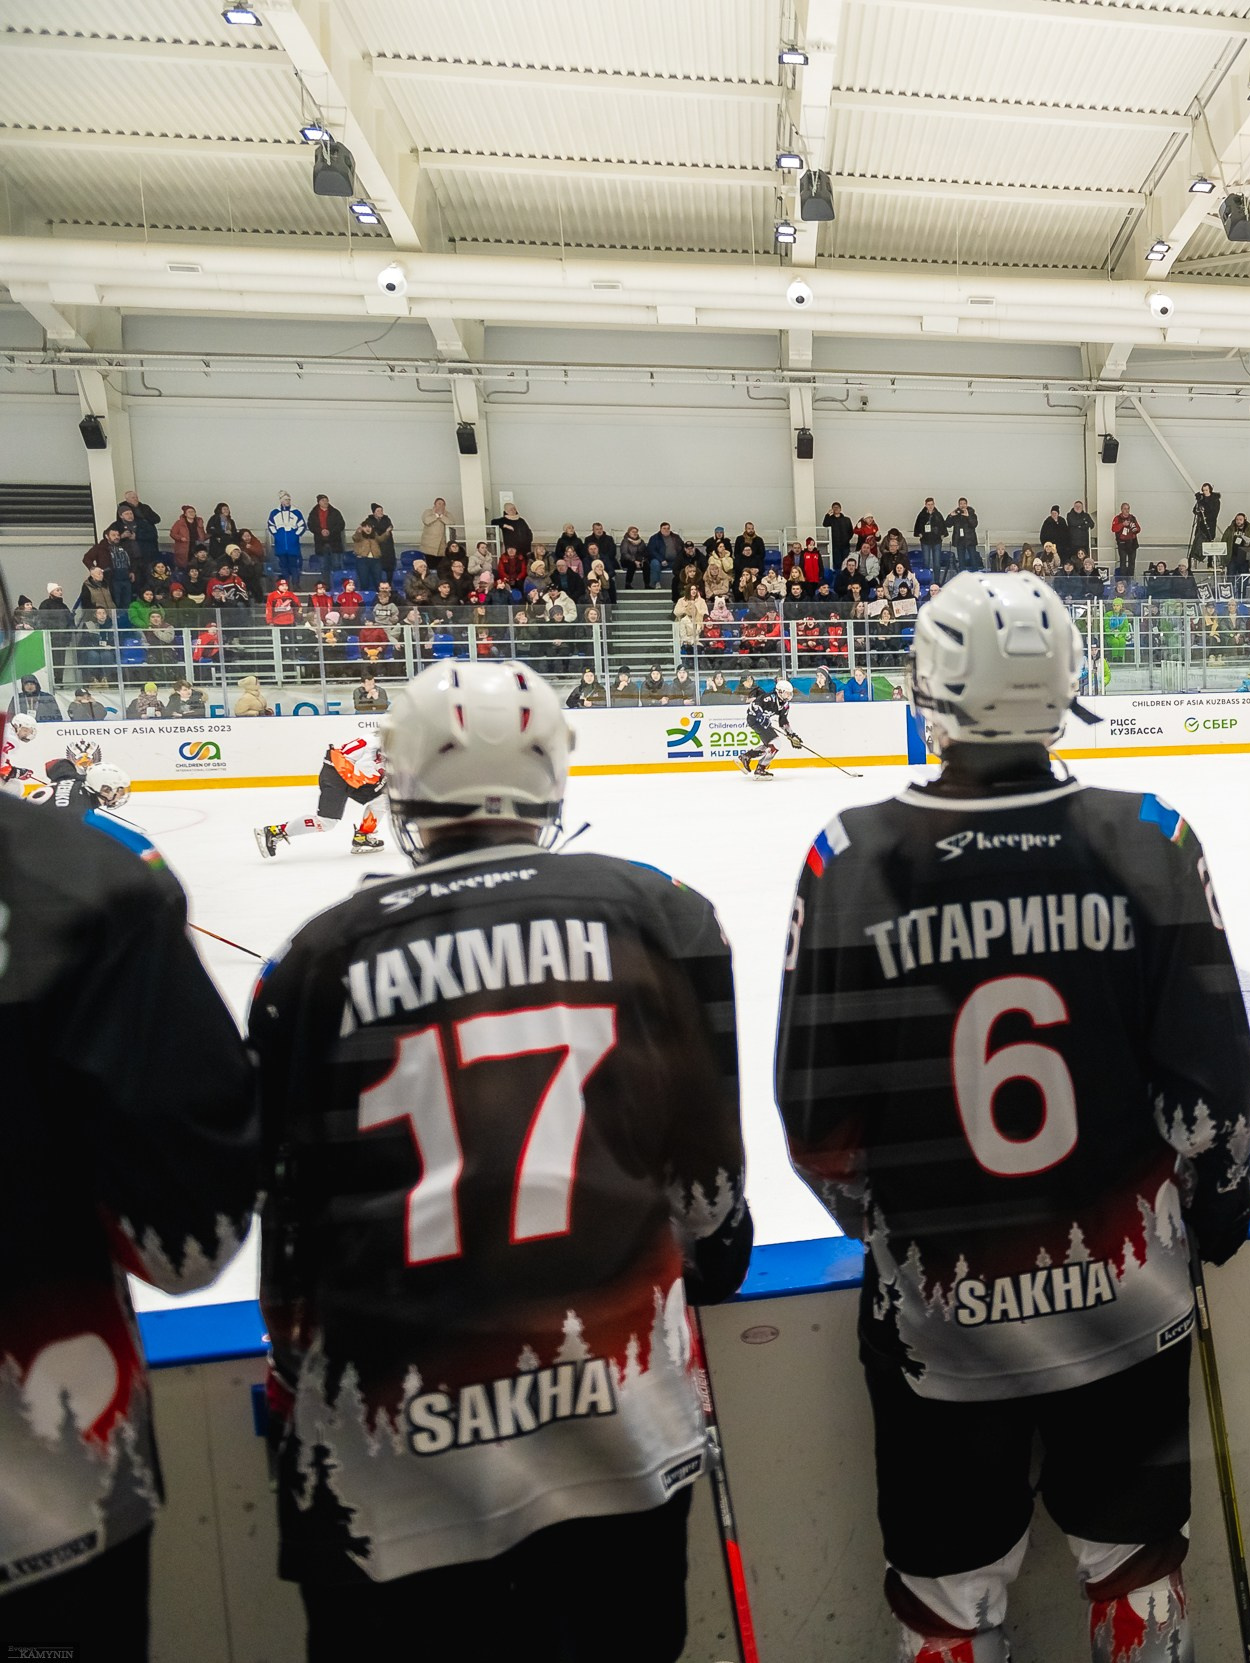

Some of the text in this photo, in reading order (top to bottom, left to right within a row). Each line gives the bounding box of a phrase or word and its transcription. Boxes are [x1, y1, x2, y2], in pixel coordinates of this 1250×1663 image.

[1132, 700, 1171, 708] CHILDREN
[1206, 698, 1240, 706] KUZBASS
[56, 724, 232, 737] CHILDREN OF ASIA KUZBASS 2023
[1110, 718, 1137, 728] РЦСС
[1110, 727, 1164, 736] КУЗБАССА
[1202, 718, 1238, 730] СБЕР
[710, 731, 761, 747] 2023
[976, 831, 1062, 851] keeper
[429, 866, 539, 896] keeper
[951, 974, 1078, 1177] 6
[357, 1003, 618, 1268] 17
[956, 1260, 1117, 1328] SAKHA
[408, 1356, 617, 1457] SAKHA
